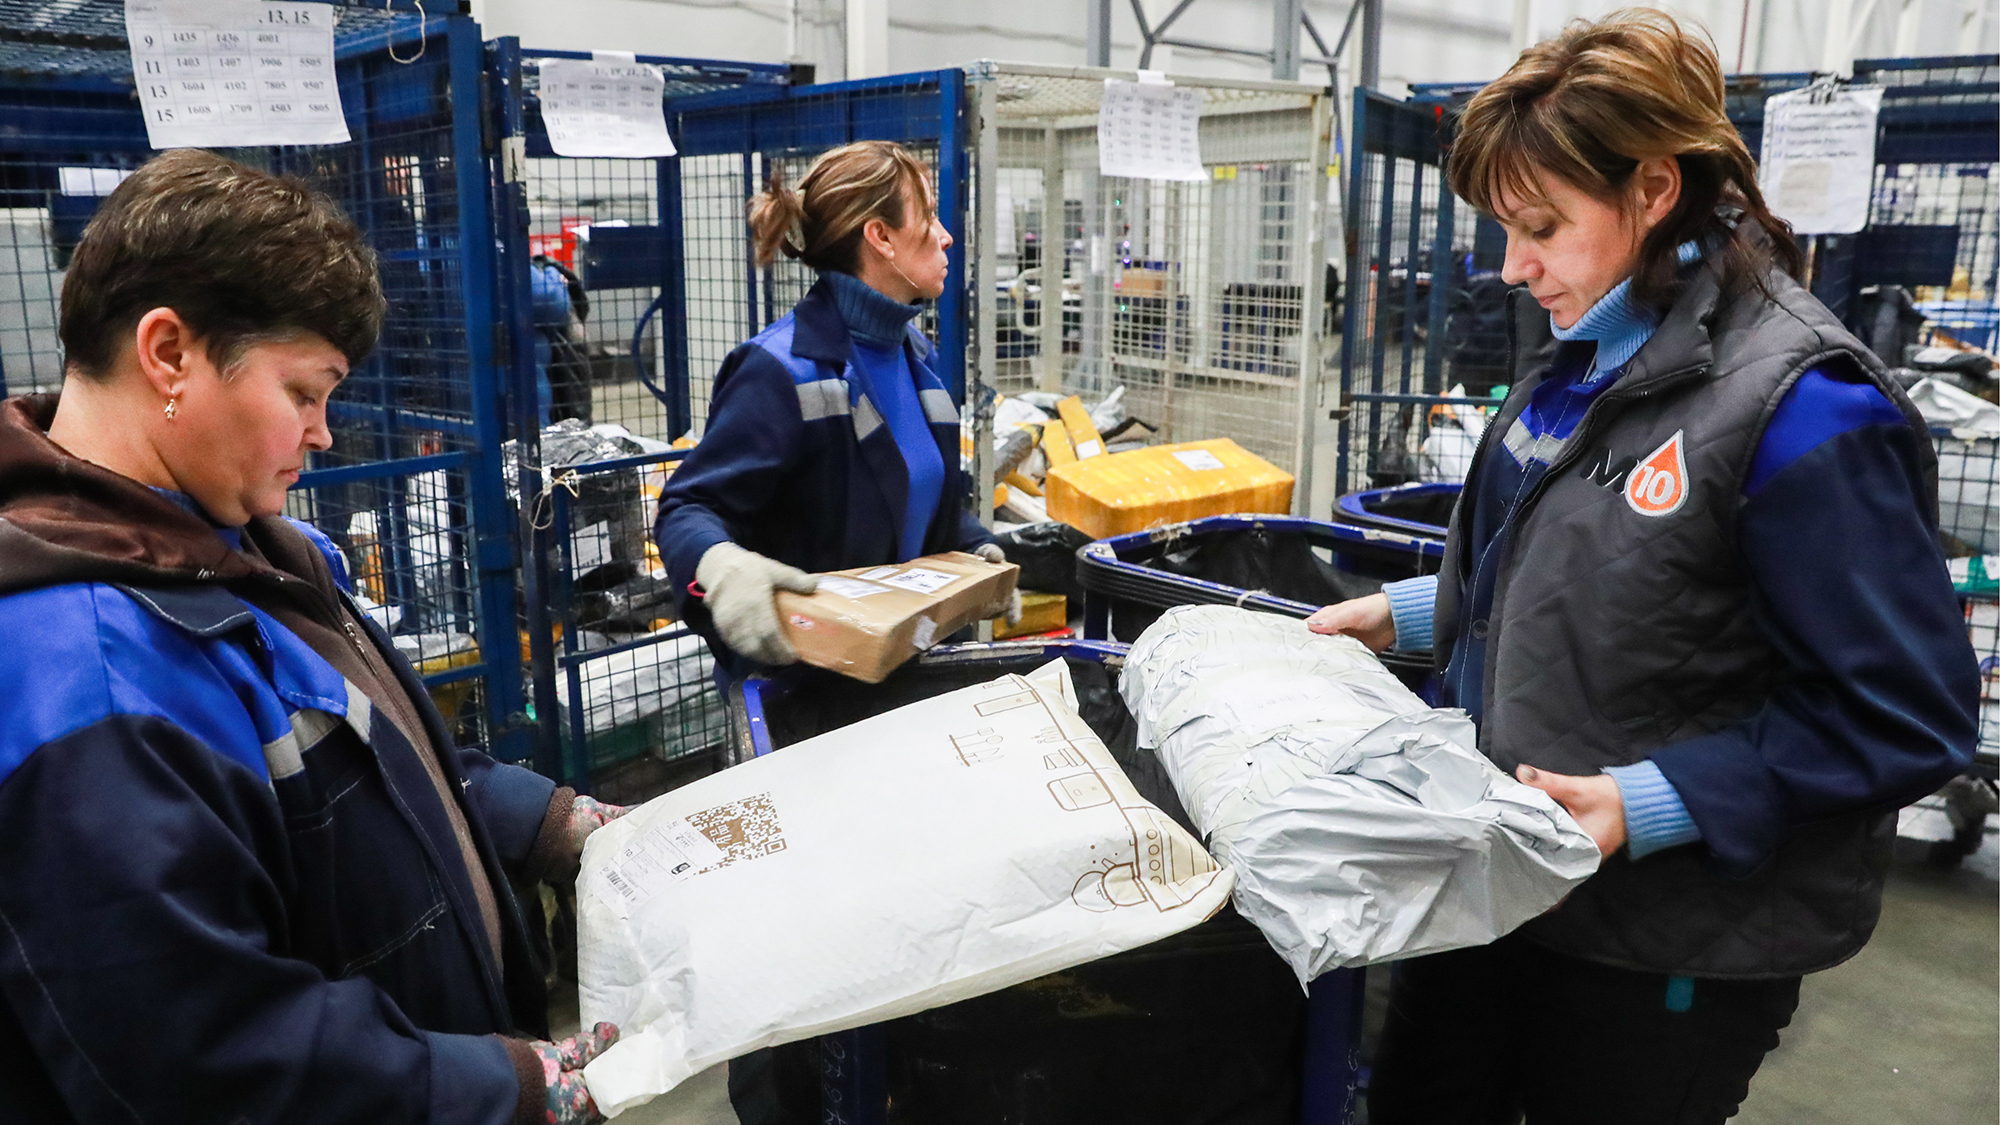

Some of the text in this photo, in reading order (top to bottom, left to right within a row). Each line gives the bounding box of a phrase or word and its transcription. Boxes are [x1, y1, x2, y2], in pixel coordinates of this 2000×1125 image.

[294, 11, 311, 24] 15
[144, 35, 154, 47] 9
[173, 33, 198, 42] 1435
[145, 61, 162, 74] 11
[150, 85, 168, 99] 13
[156, 109, 174, 122] 15
[1635, 465, 1676, 505] 10
